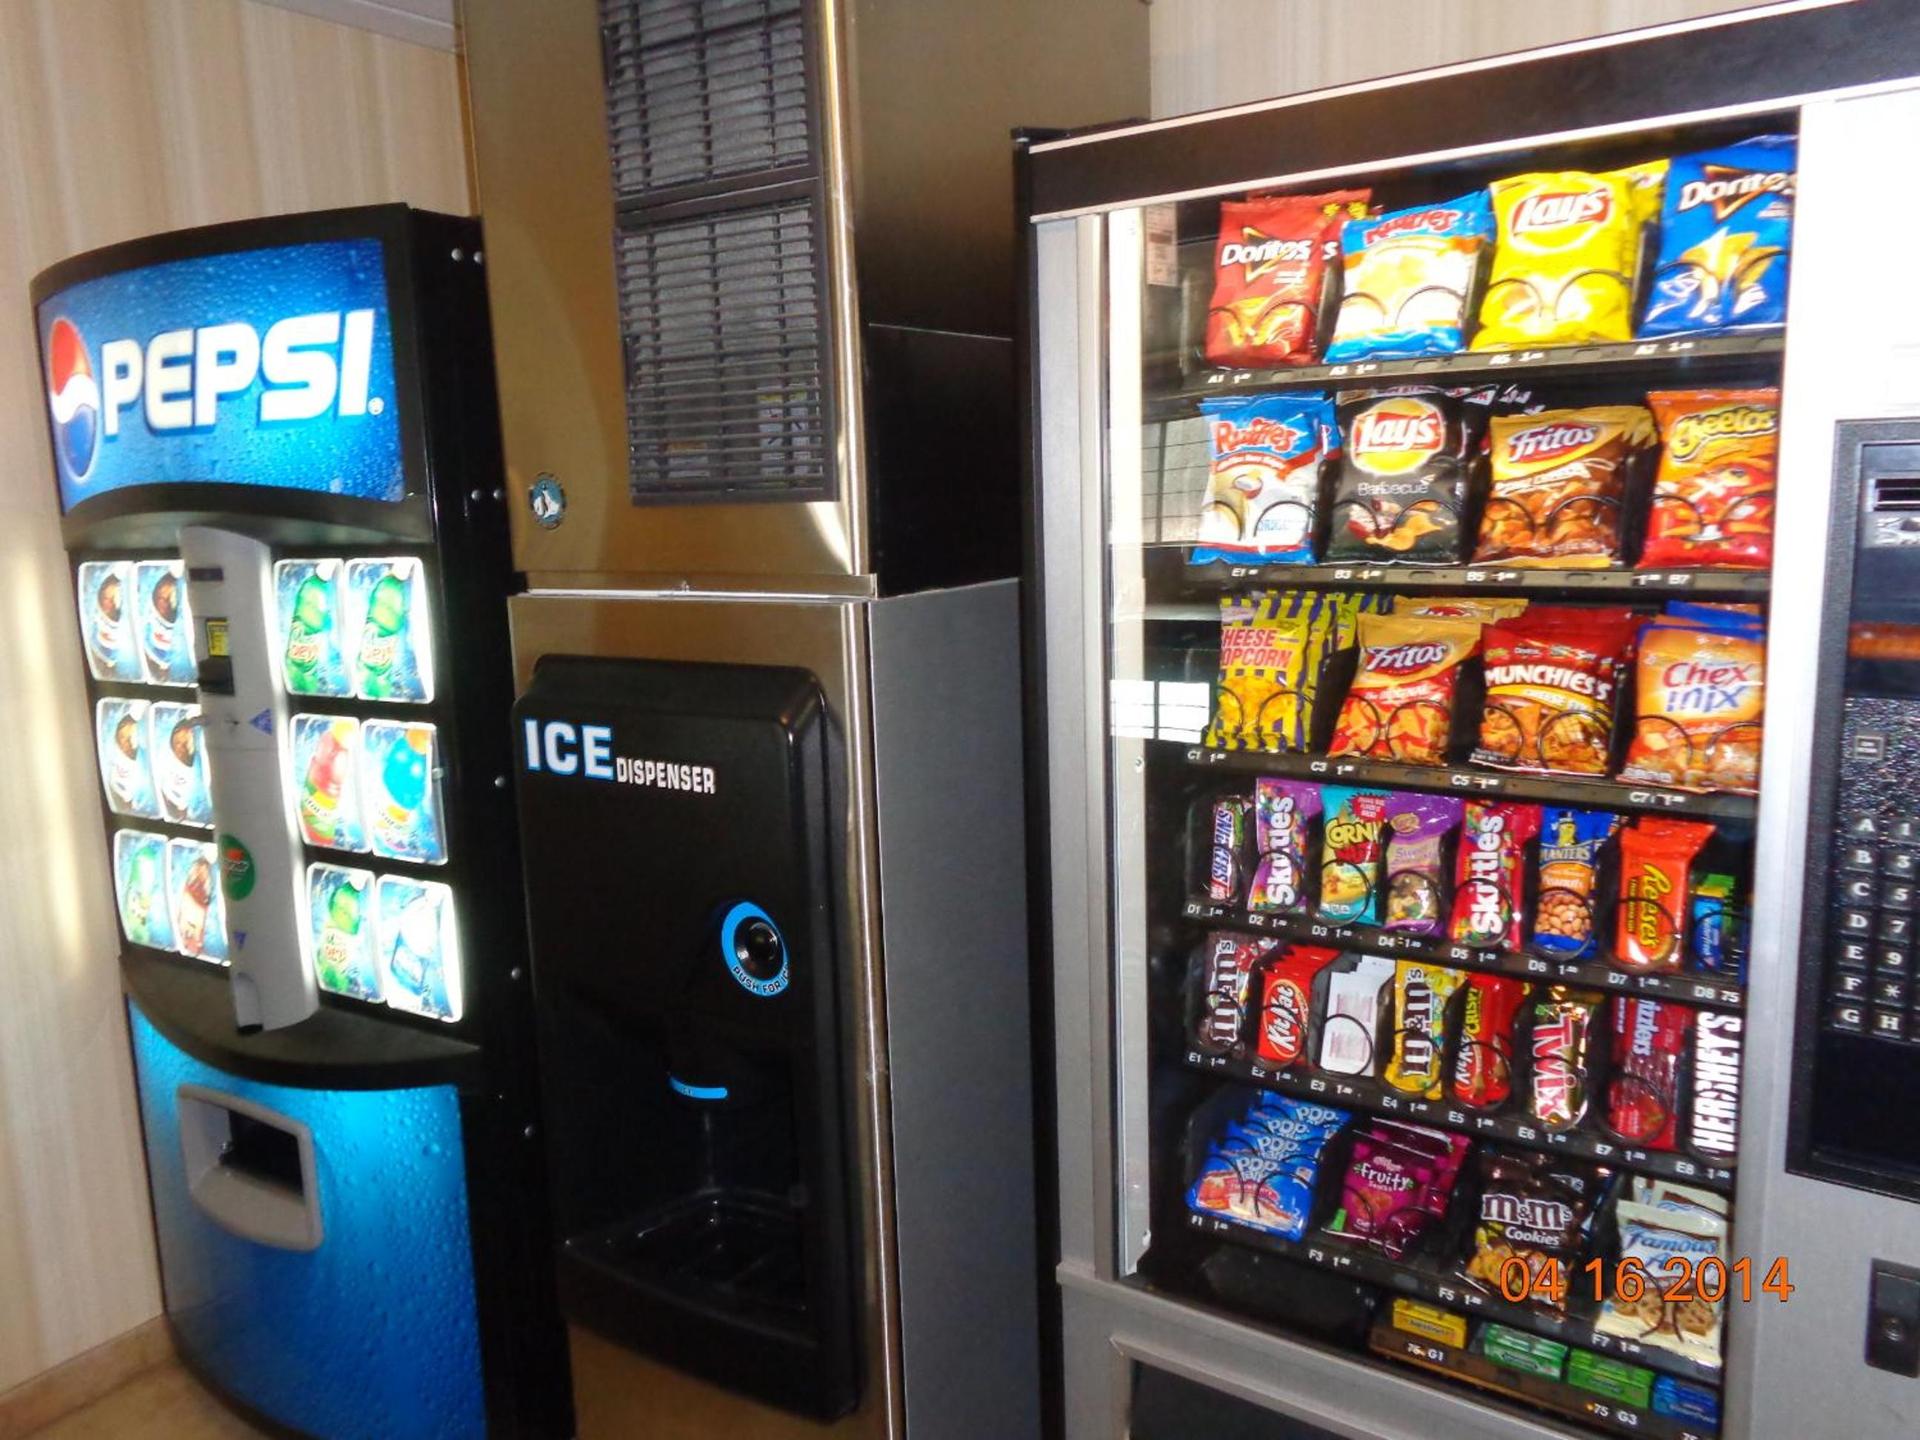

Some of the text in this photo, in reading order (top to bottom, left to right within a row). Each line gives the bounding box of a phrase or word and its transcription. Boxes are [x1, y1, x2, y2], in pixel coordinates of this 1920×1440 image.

[1220, 239, 1314, 267] Doritos
[101, 308, 376, 437] PEPSI
[1508, 425, 1599, 463] Fritos
[1357, 481, 1430, 497] Barbecue
[1221, 626, 1278, 648] HEESE
[1221, 648, 1293, 669] OPCORN
[1365, 643, 1449, 672] Fritos
[1484, 663, 1597, 696] MUNCHIES
[1663, 661, 1757, 688] Chex
[522, 717, 615, 781] ICE
[616, 756, 717, 795] DISPENSER
[1857, 818, 1875, 833] A
[1266, 796, 1297, 907] Skitles
[1855, 850, 1911, 868] B 3
[1853, 882, 1909, 901] C 5
[1249, 914, 1264, 926] D2
[1849, 914, 1906, 934] D 7
[1312, 925, 1328, 937] D3
[1378, 936, 1395, 948] D4
[1451, 948, 1468, 960] D5
[1846, 945, 1903, 966] E 9
[1528, 959, 1547, 973] D6
[732, 966, 759, 993] PUSH
[762, 980, 780, 993] FOR
[1608, 972, 1628, 985] D7
[1843, 977, 1863, 991] F
[1841, 1008, 1900, 1031] G H
[1310, 1079, 1326, 1092] E3
[1383, 1096, 1398, 1109] E4
[1448, 1110, 1465, 1123] E5
[1518, 1126, 1535, 1140] E6
[1595, 1143, 1613, 1156] E7
[1675, 1161, 1695, 1175] E8
[1505, 1226, 1560, 1246] Cookies
[1621, 1225, 1719, 1255] Famous
[1309, 1249, 1323, 1262] F3
[1438, 1287, 1455, 1302] F5
[1591, 1332, 1611, 1348] F7
[1616, 1409, 1639, 1426] G3
